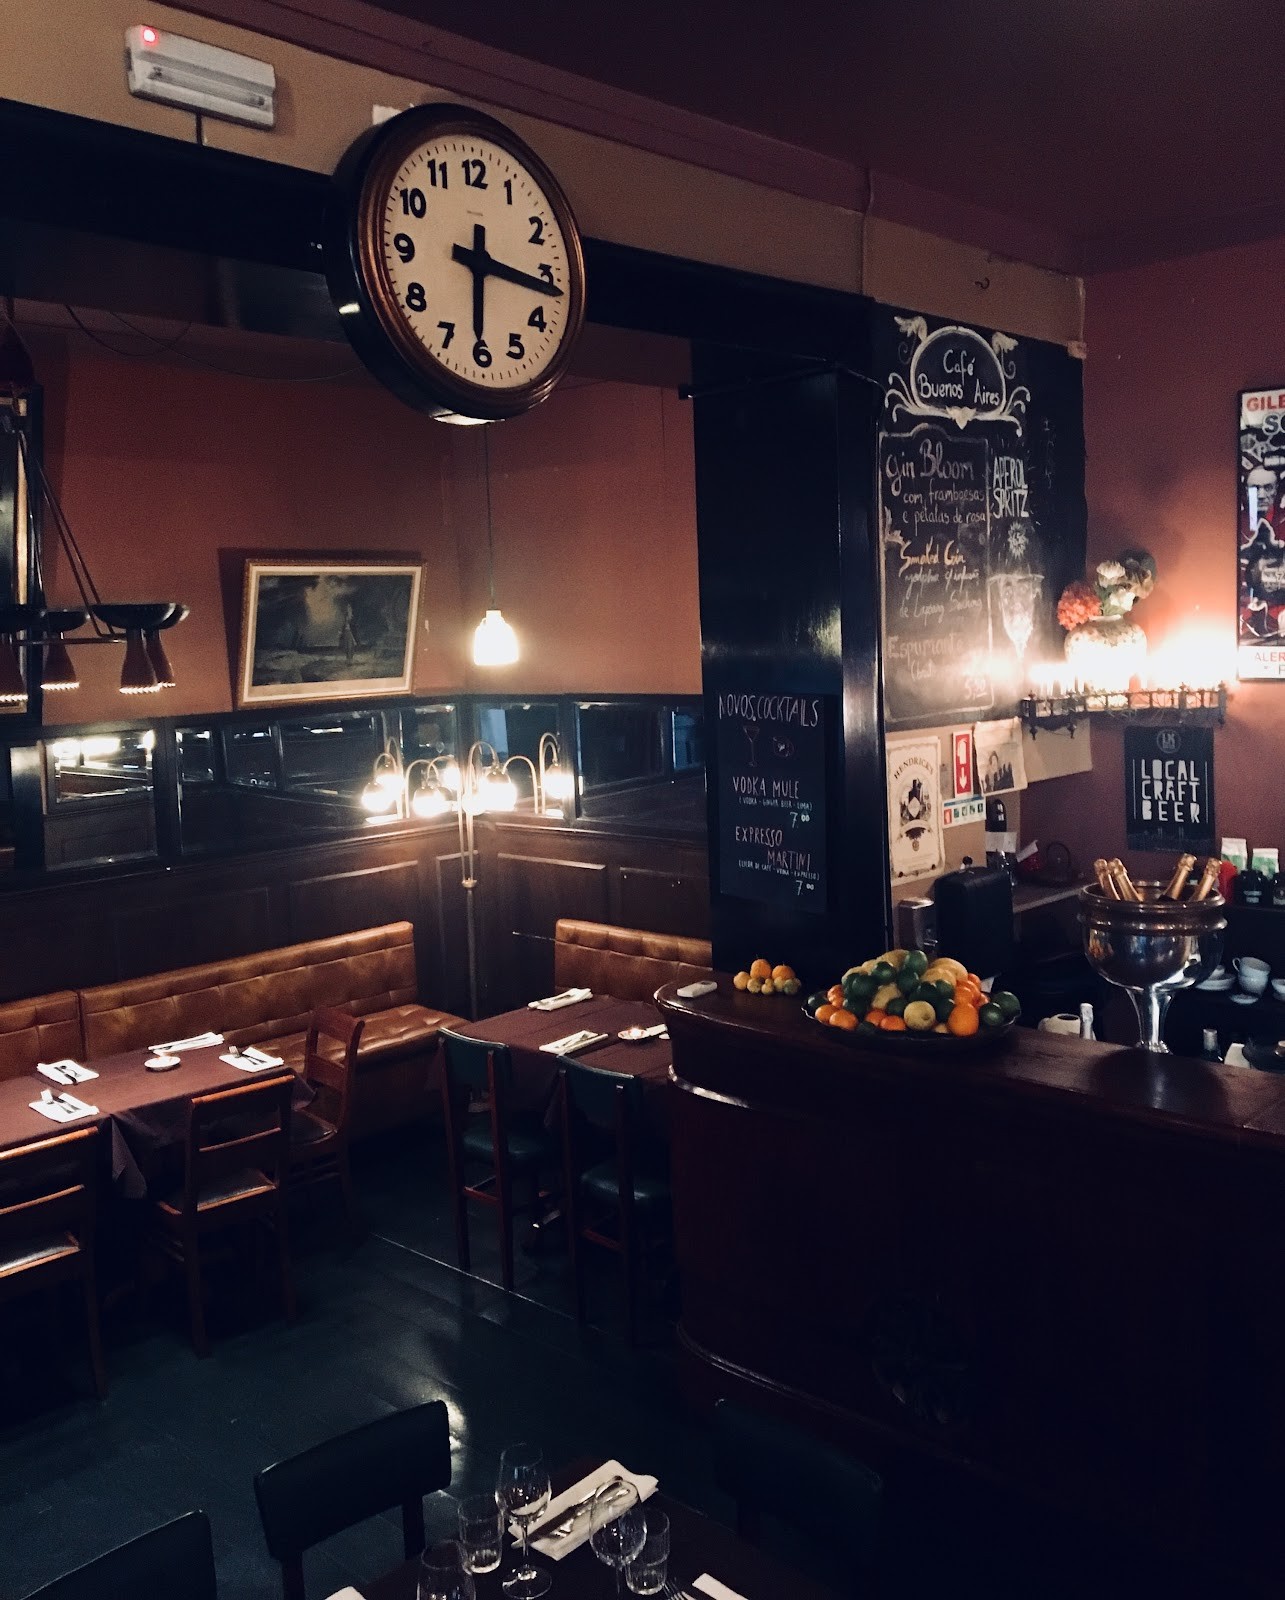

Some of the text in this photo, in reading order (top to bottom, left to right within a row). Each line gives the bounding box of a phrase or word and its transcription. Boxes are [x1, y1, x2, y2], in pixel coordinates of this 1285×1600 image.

[427, 159, 448, 189] 11
[461, 159, 488, 189] 12
[400, 187, 427, 218] 10
[503, 179, 513, 205] 1
[528, 216, 545, 245] 2
[394, 233, 415, 263] 9
[538, 263, 554, 288] 3
[406, 282, 427, 312] 8
[527, 305, 547, 332] 4
[437, 321, 455, 349] 7
[506, 333, 525, 360] 5
[472, 339, 492, 368] 6
[943, 350, 976, 385] Café
[917, 373, 1000, 405] Buenos Aires
[920, 439, 975, 480] Bloom
[993, 456, 1028, 490] APEROL
[903, 493, 923, 504] com
[993, 487, 1030, 519] SPRITZ
[953, 507, 963, 524] de
[965, 511, 986, 524] rosa
[757, 696, 819, 727] COCKTAILS
[1141, 759, 1200, 781] LOCAL
[733, 776, 800, 799] VODKA MULE
[1141, 780, 1200, 802] CRAFT
[1142, 800, 1200, 823] BEER
[735, 826, 783, 847] EXPRESSO
[767, 850, 811, 871] MARTINI
